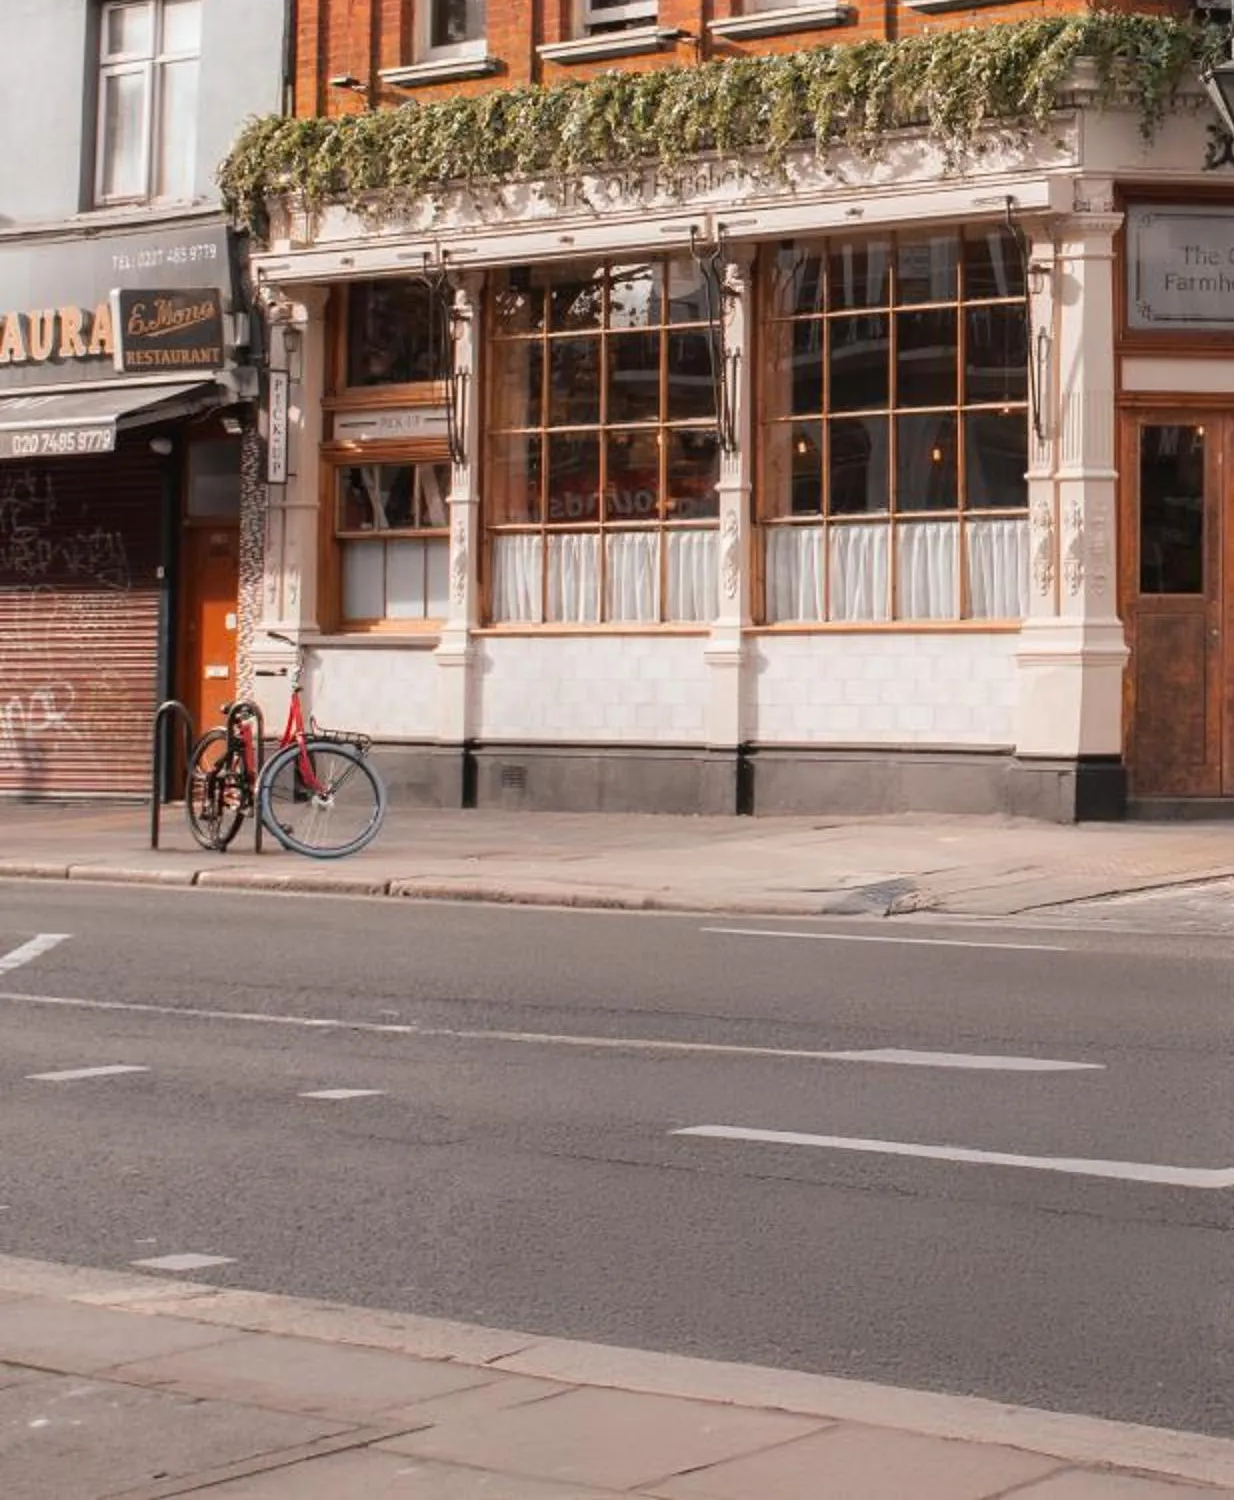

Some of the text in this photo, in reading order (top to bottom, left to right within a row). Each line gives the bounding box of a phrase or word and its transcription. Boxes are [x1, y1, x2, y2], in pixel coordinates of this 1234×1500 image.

[1183, 246, 1222, 266] The
[125, 347, 220, 365] RESTAURANT
[12, 434, 39, 454] 020
[78, 429, 111, 449] 9779
